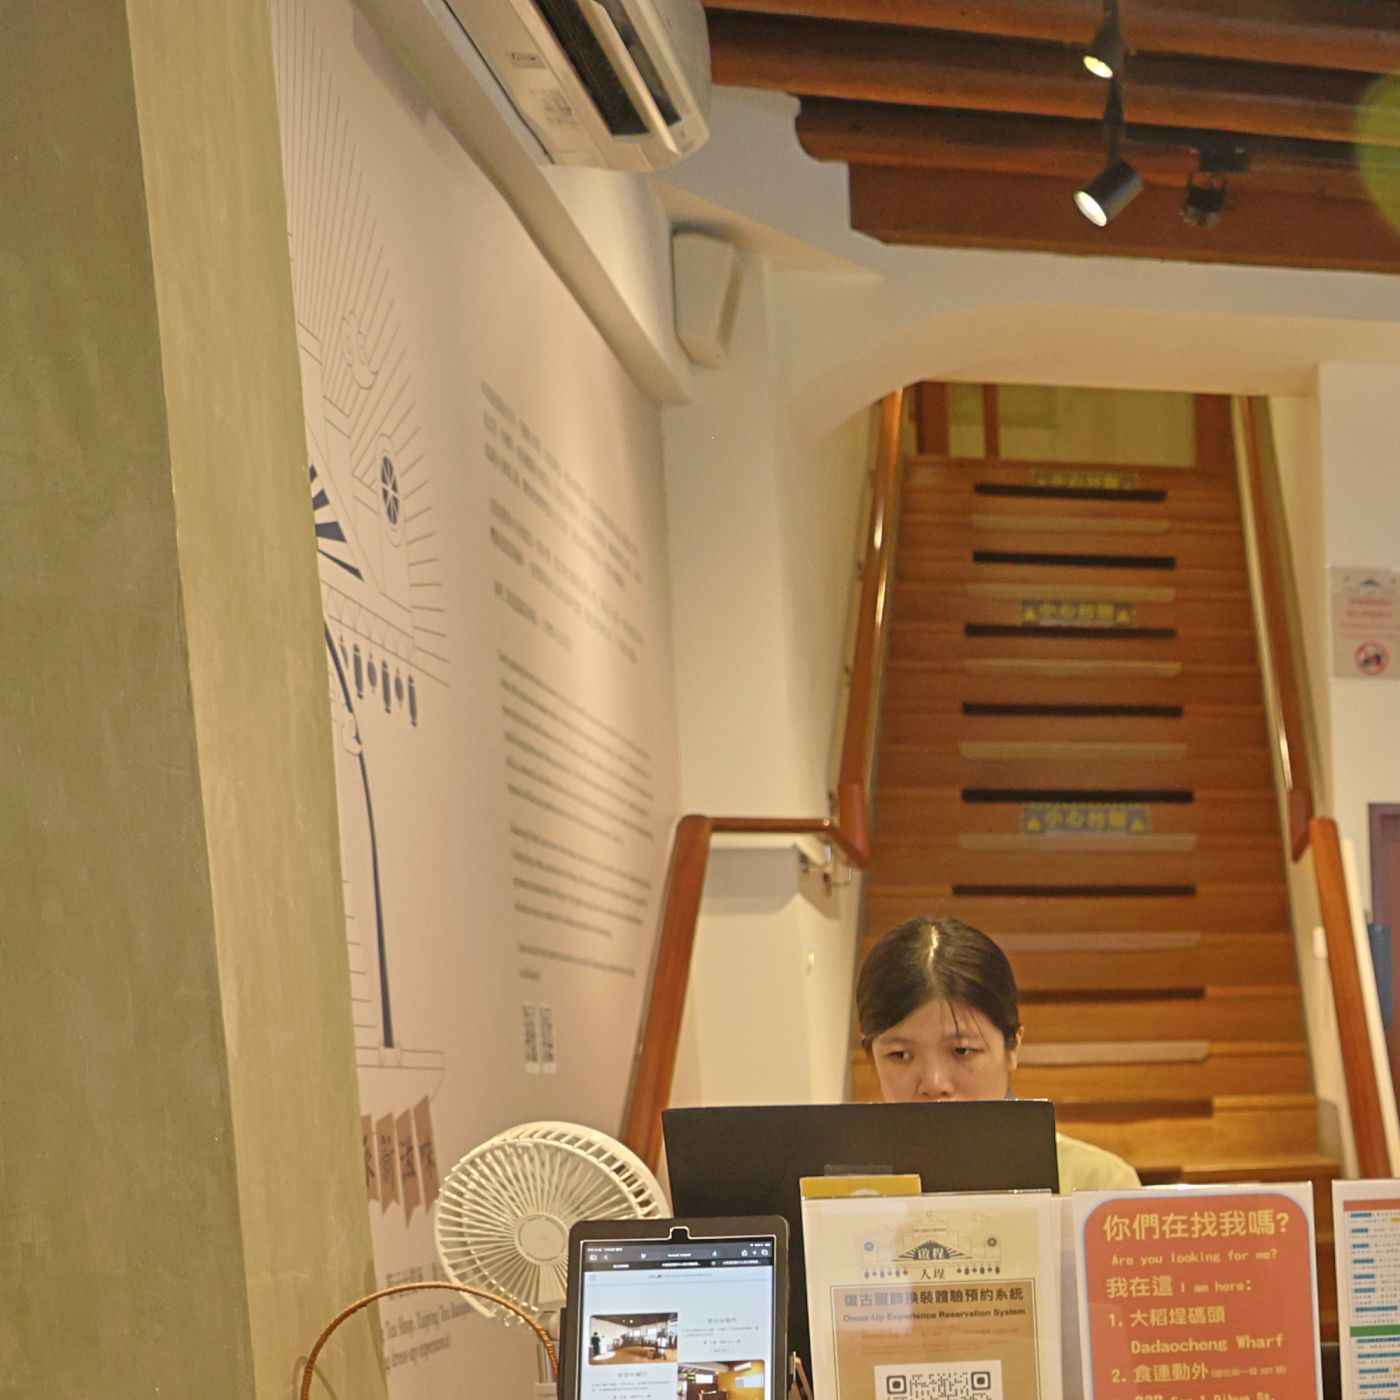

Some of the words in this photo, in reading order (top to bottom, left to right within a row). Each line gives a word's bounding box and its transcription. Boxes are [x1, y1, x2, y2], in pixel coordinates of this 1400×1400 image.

[1103, 1208, 1290, 1242] 你們在找我嗎?
[1111, 1254, 1134, 1266] Are
[1140, 1254, 1163, 1266] you
[1170, 1251, 1221, 1264] looking
[1228, 1249, 1248, 1261] for
[1255, 1248, 1278, 1261] me?
[1106, 1275, 1174, 1299] 我在這
[1193, 1283, 1210, 1293] am
[1214, 1279, 1253, 1293] here:
[886, 1311, 938, 1322] Experience
[938, 1307, 992, 1319] Reservation
[993, 1307, 1027, 1319] System
[1107, 1313, 1124, 1328] 1.
[1129, 1305, 1227, 1328] 大稻埕碼頭
[1130, 1338, 1228, 1355] Dadaocheng
[1236, 1333, 1285, 1349] Wharf
[1110, 1368, 1127, 1384] 2.
